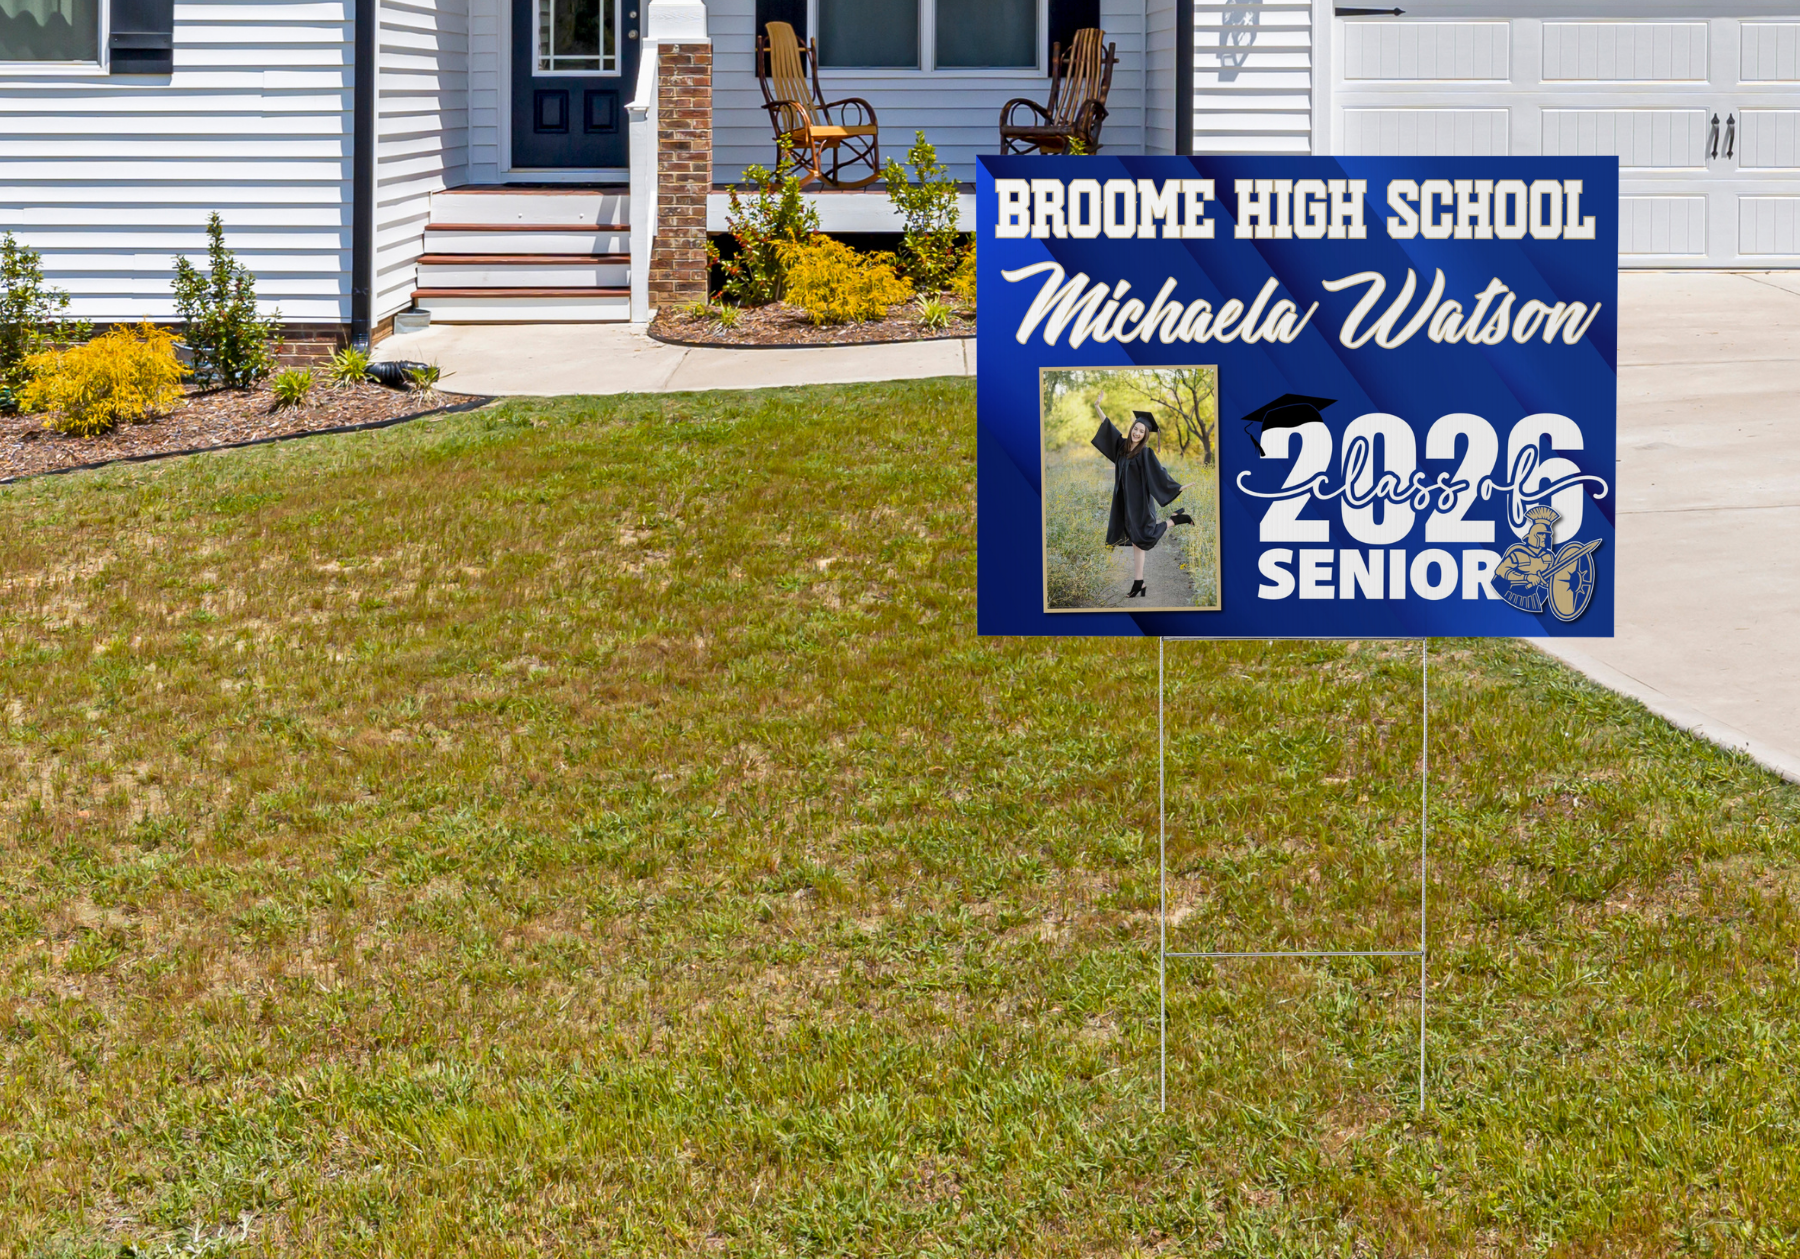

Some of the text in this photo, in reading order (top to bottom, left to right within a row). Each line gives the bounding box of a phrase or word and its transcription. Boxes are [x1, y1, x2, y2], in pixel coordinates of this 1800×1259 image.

[994, 178, 1597, 240] BROOME HIGH SCHOOL
[1001, 261, 1602, 349] Michaela Watson
[1236, 436, 1608, 524] class of
[1259, 412, 1584, 544] 2026
[1257, 548, 1502, 600] SENIOR
